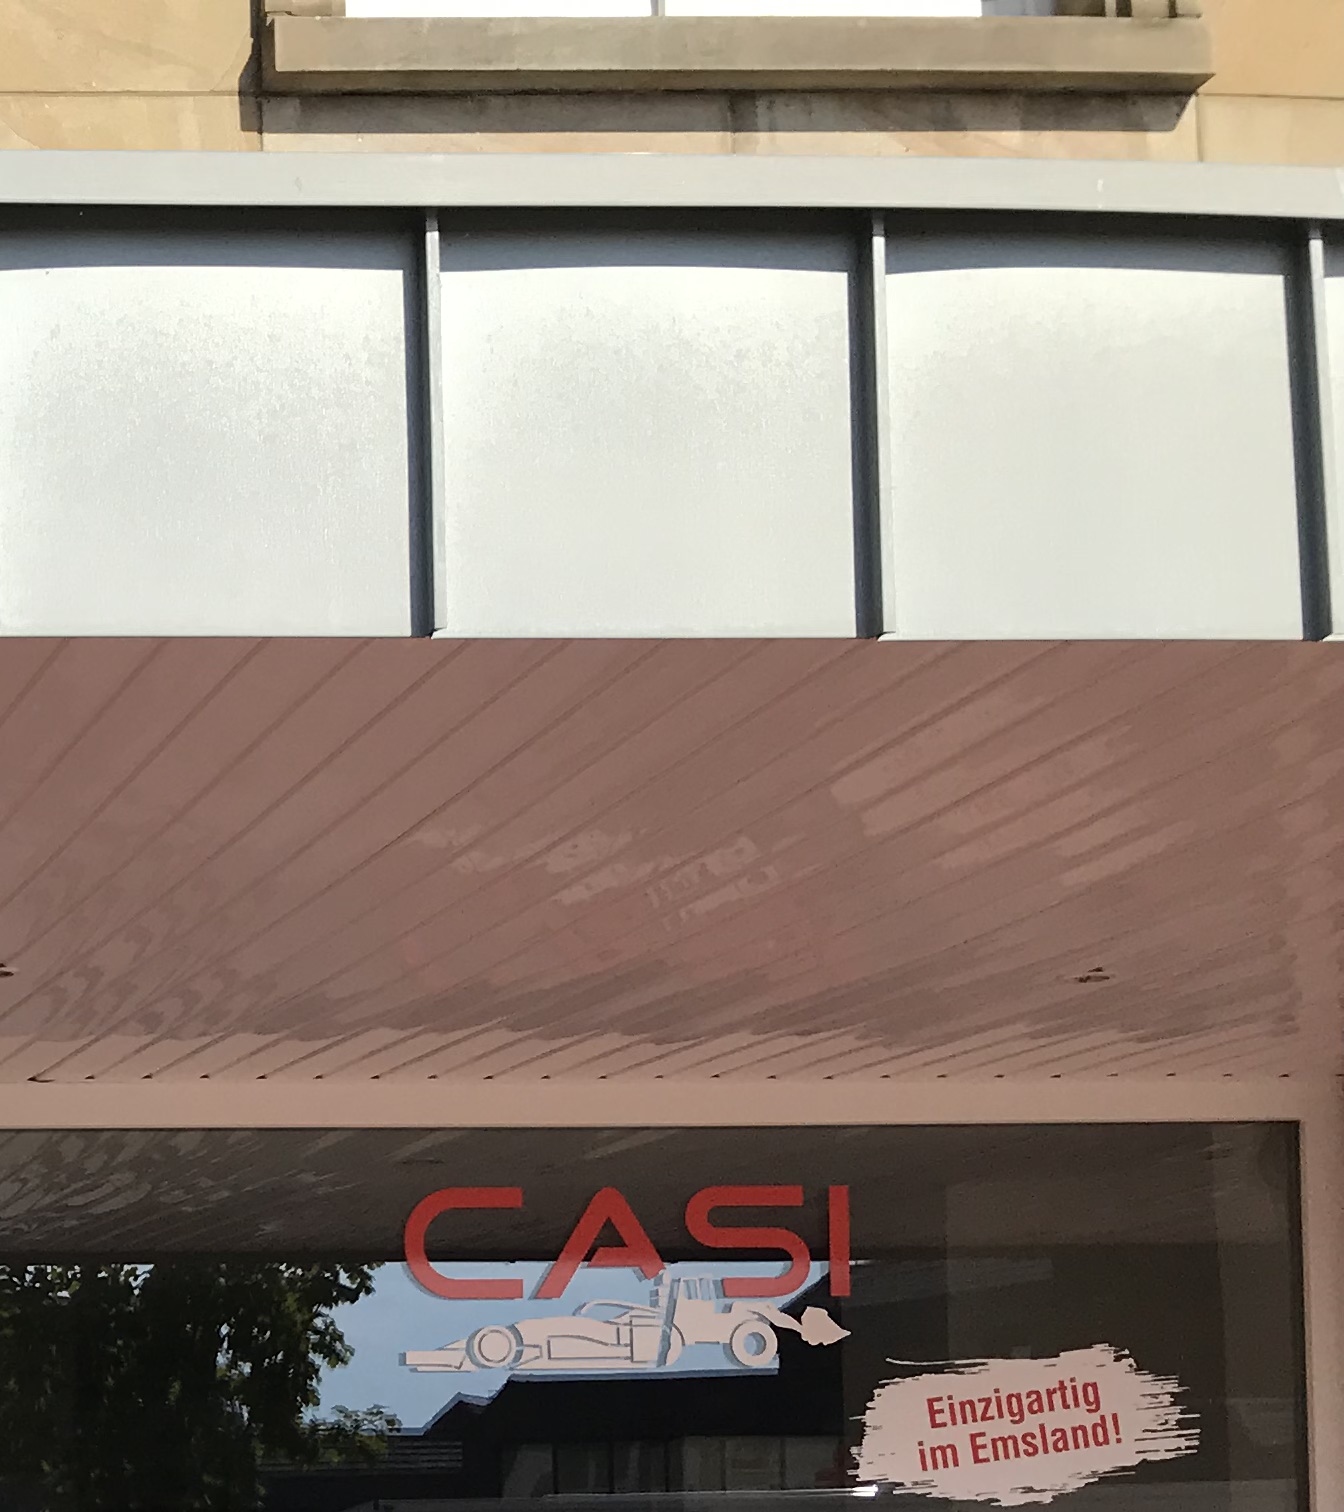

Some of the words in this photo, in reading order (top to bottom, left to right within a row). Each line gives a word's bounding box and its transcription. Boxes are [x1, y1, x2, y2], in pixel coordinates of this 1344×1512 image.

[404, 1185, 850, 1299] CASI
[927, 1377, 1101, 1429] Einzigartig
[918, 1440, 959, 1472] im
[969, 1412, 1123, 1464] Emsland!
